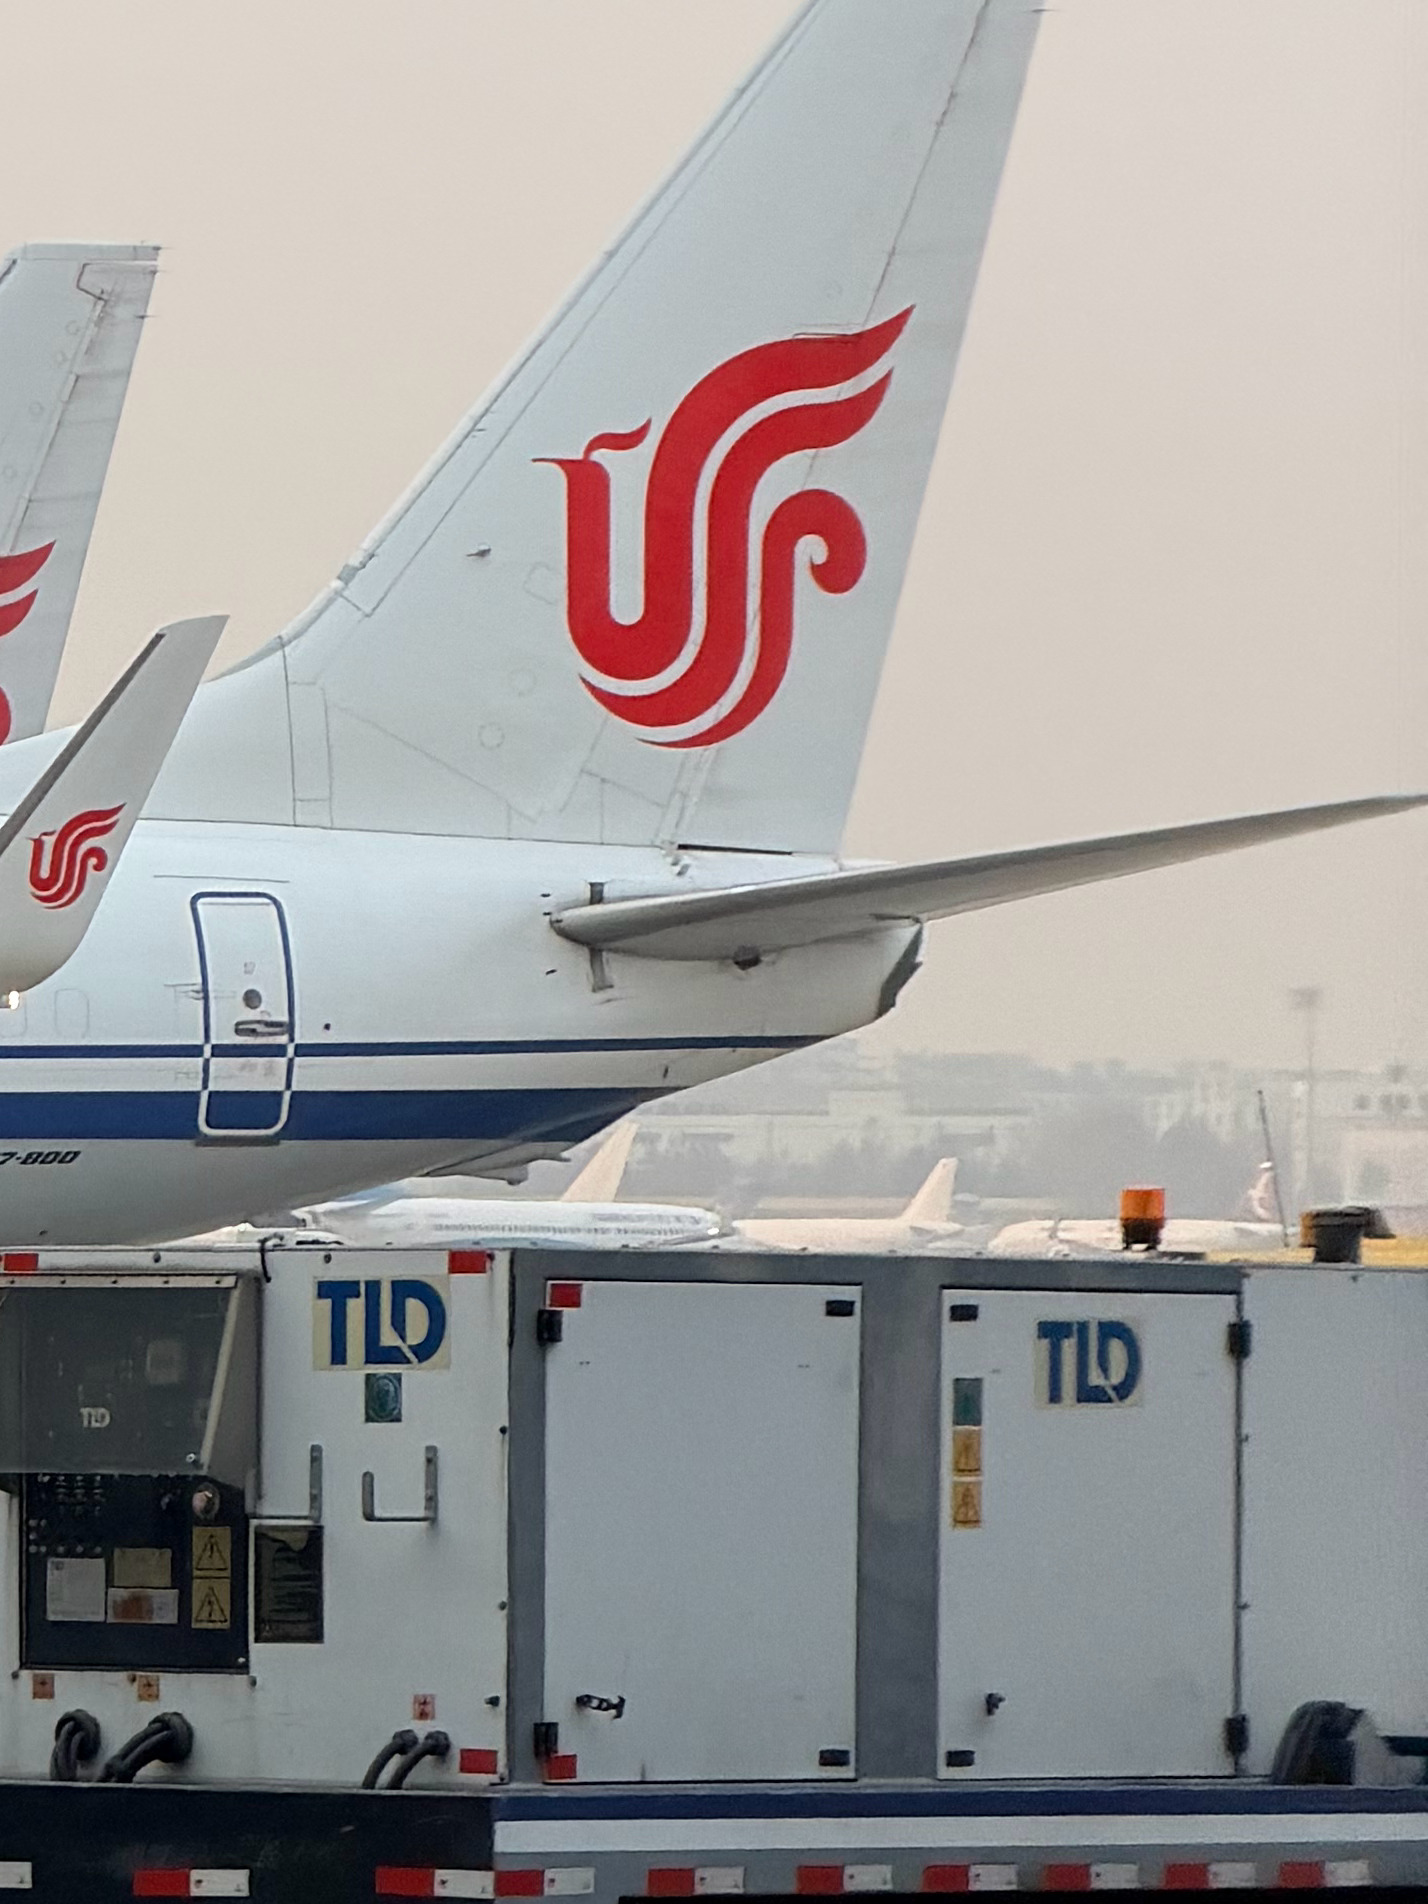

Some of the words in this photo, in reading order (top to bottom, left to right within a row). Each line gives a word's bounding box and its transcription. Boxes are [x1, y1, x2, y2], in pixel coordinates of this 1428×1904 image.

[317, 1280, 446, 1365] TLD
[1037, 1320, 1142, 1404] TLD
[79, 1406, 112, 1428] TLD
